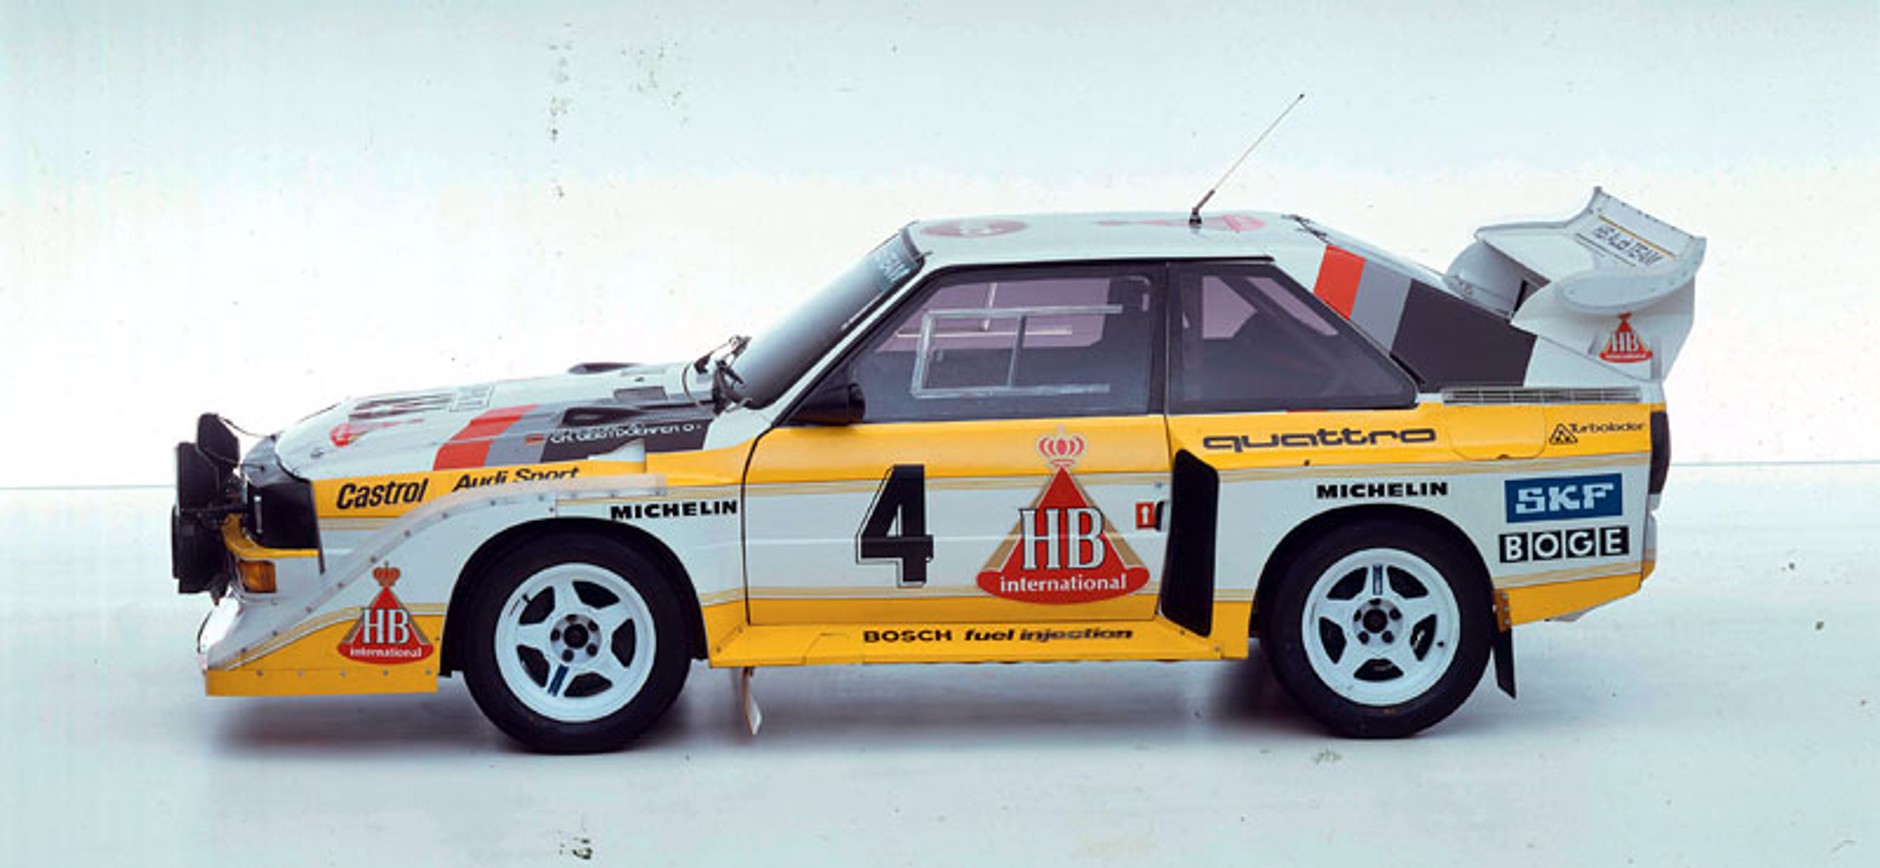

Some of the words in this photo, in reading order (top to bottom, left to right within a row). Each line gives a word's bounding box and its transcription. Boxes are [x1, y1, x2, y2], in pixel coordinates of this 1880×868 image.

[1610, 330, 1639, 352] HB
[1202, 428, 1437, 452] quattro
[451, 470, 508, 492] Audi
[1315, 481, 1449, 500] MICHELIN
[336, 478, 429, 509] Castrol
[1515, 482, 1614, 514] SKF
[610, 500, 738, 519] MICHELIN
[856, 464, 934, 588] 4
[1018, 508, 1106, 571] HB
[1504, 528, 1622, 561] BOGE
[999, 574, 1127, 593] international
[362, 607, 410, 645] HB
[863, 629, 953, 643] BOSCH
[963, 628, 1015, 641] fuel
[1019, 627, 1134, 643] injection
[349, 645, 422, 657] international
